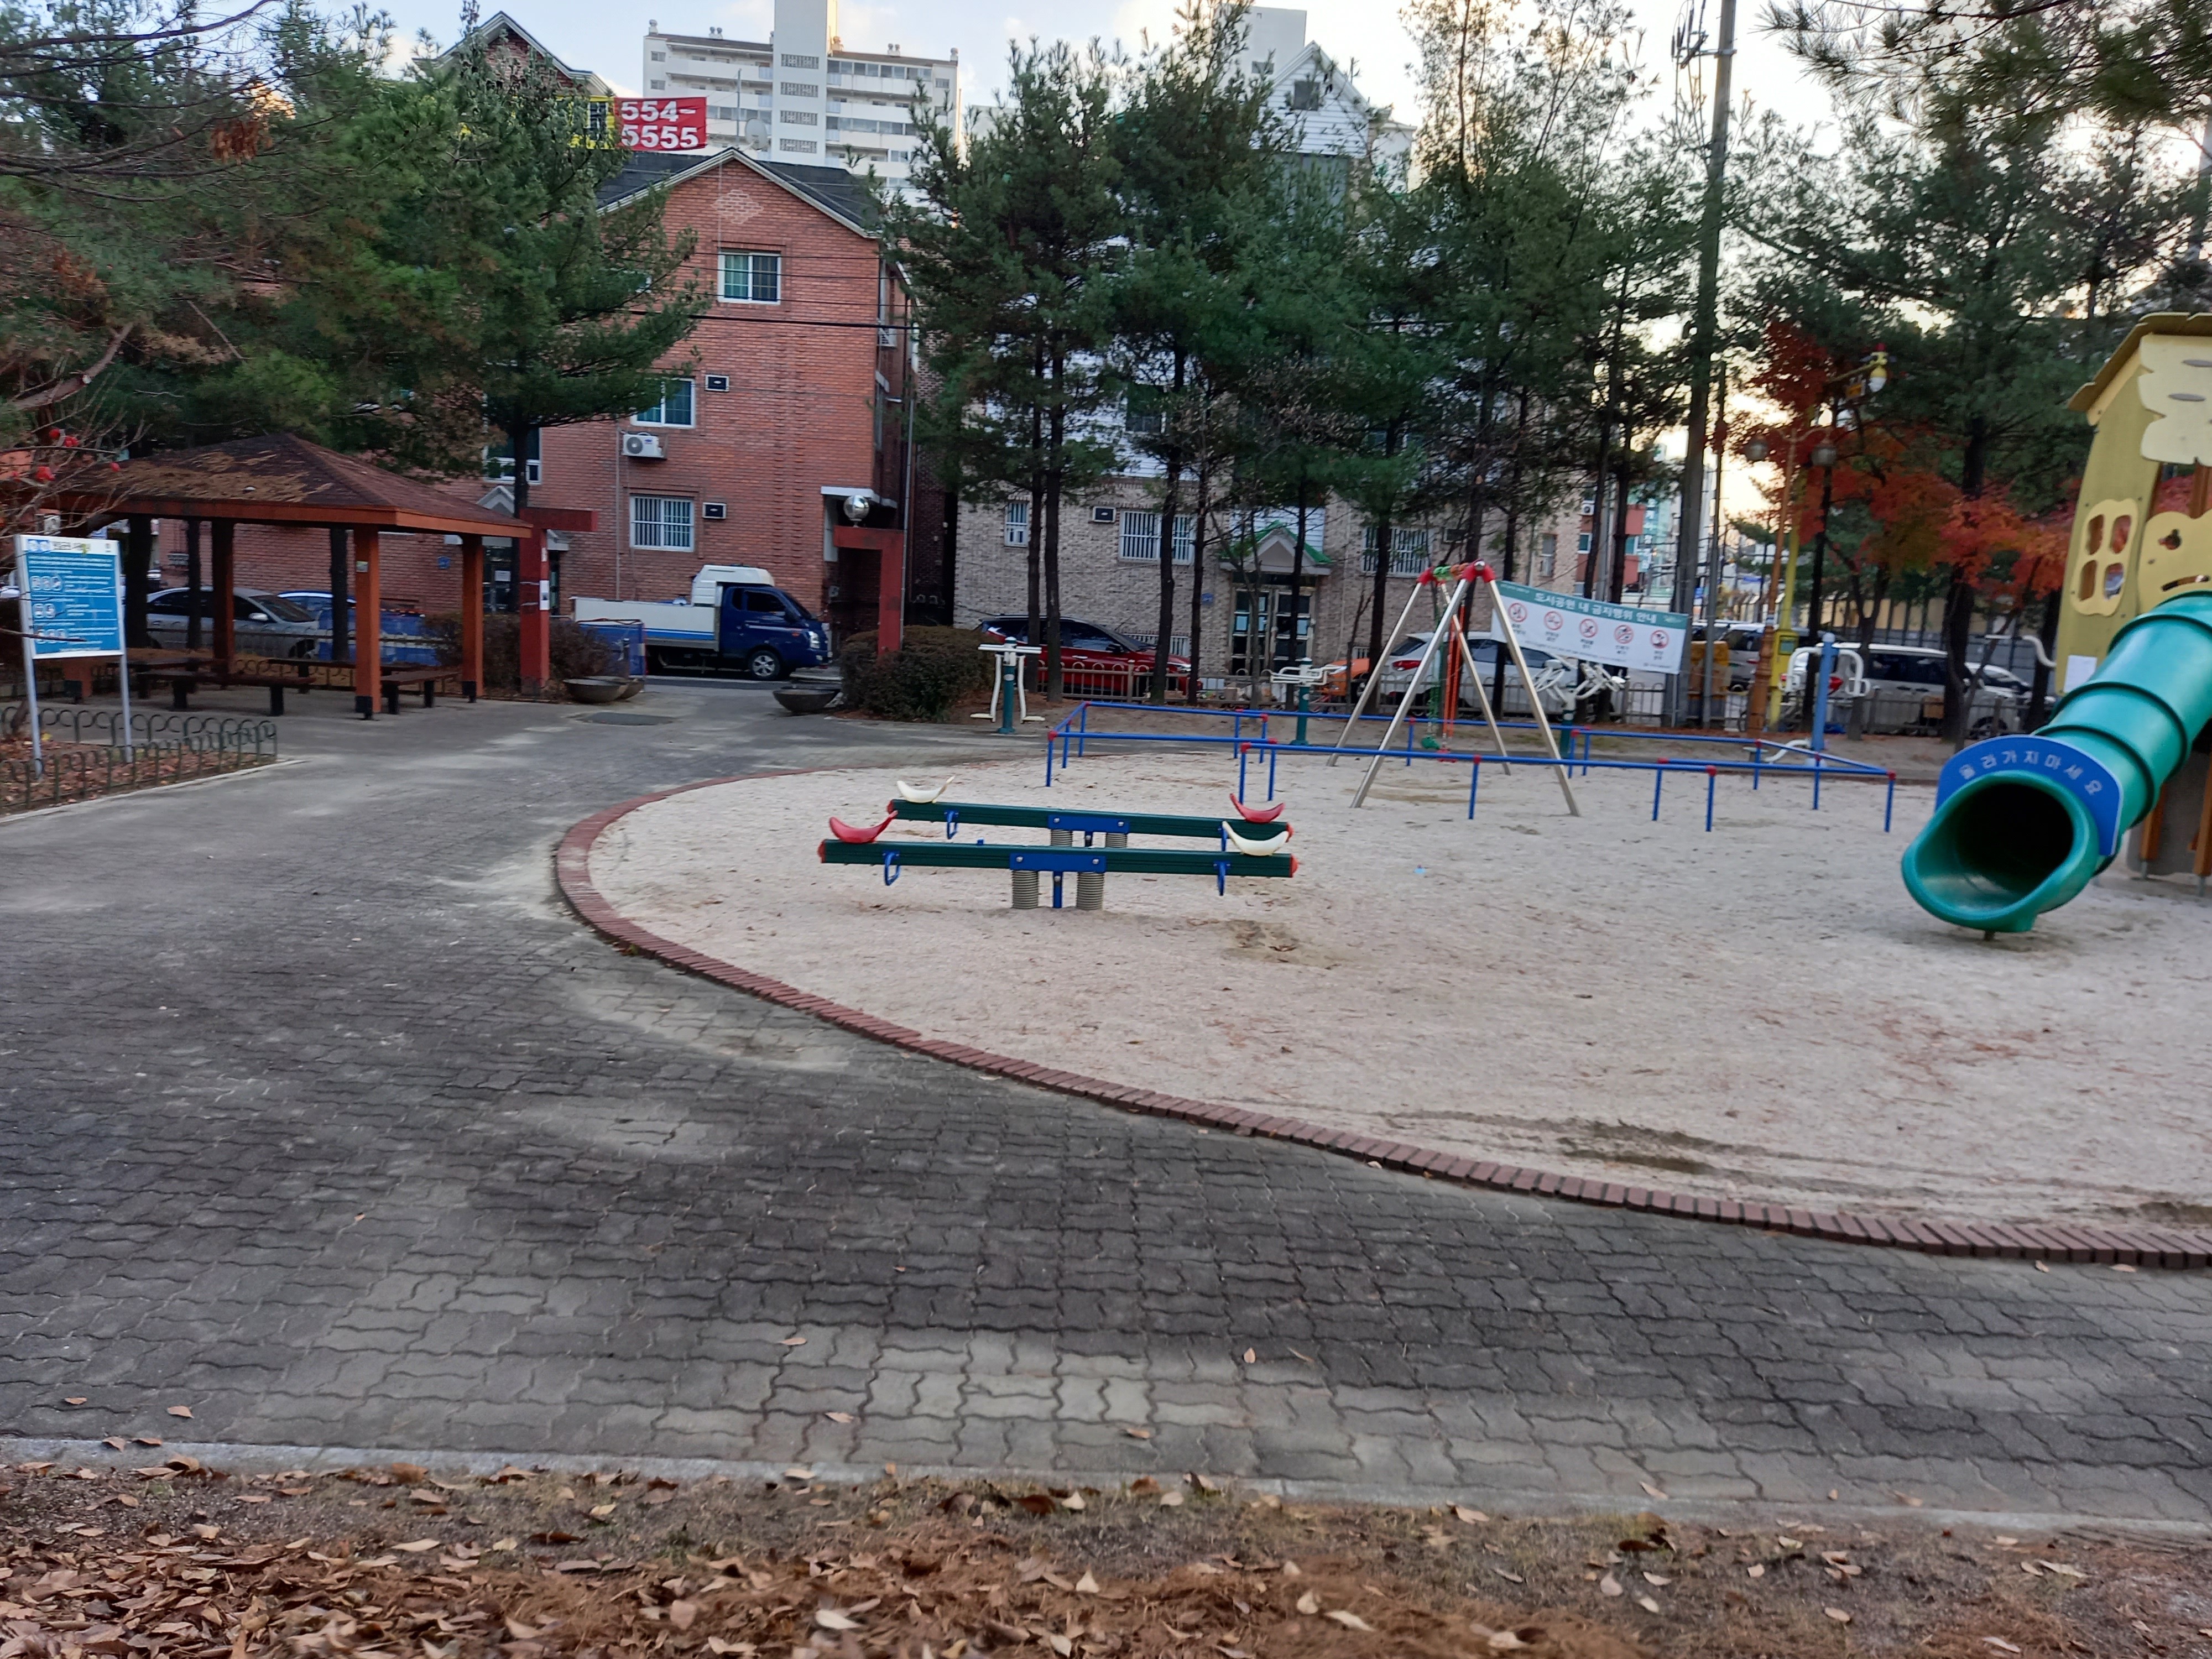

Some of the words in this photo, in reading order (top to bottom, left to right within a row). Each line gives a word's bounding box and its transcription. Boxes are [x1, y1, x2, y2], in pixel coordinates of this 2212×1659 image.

[620, 100, 696, 122] 554-
[620, 124, 699, 149] 5555
[1578, 602, 1590, 613] 내
[1636, 612, 1657, 624] 안내
